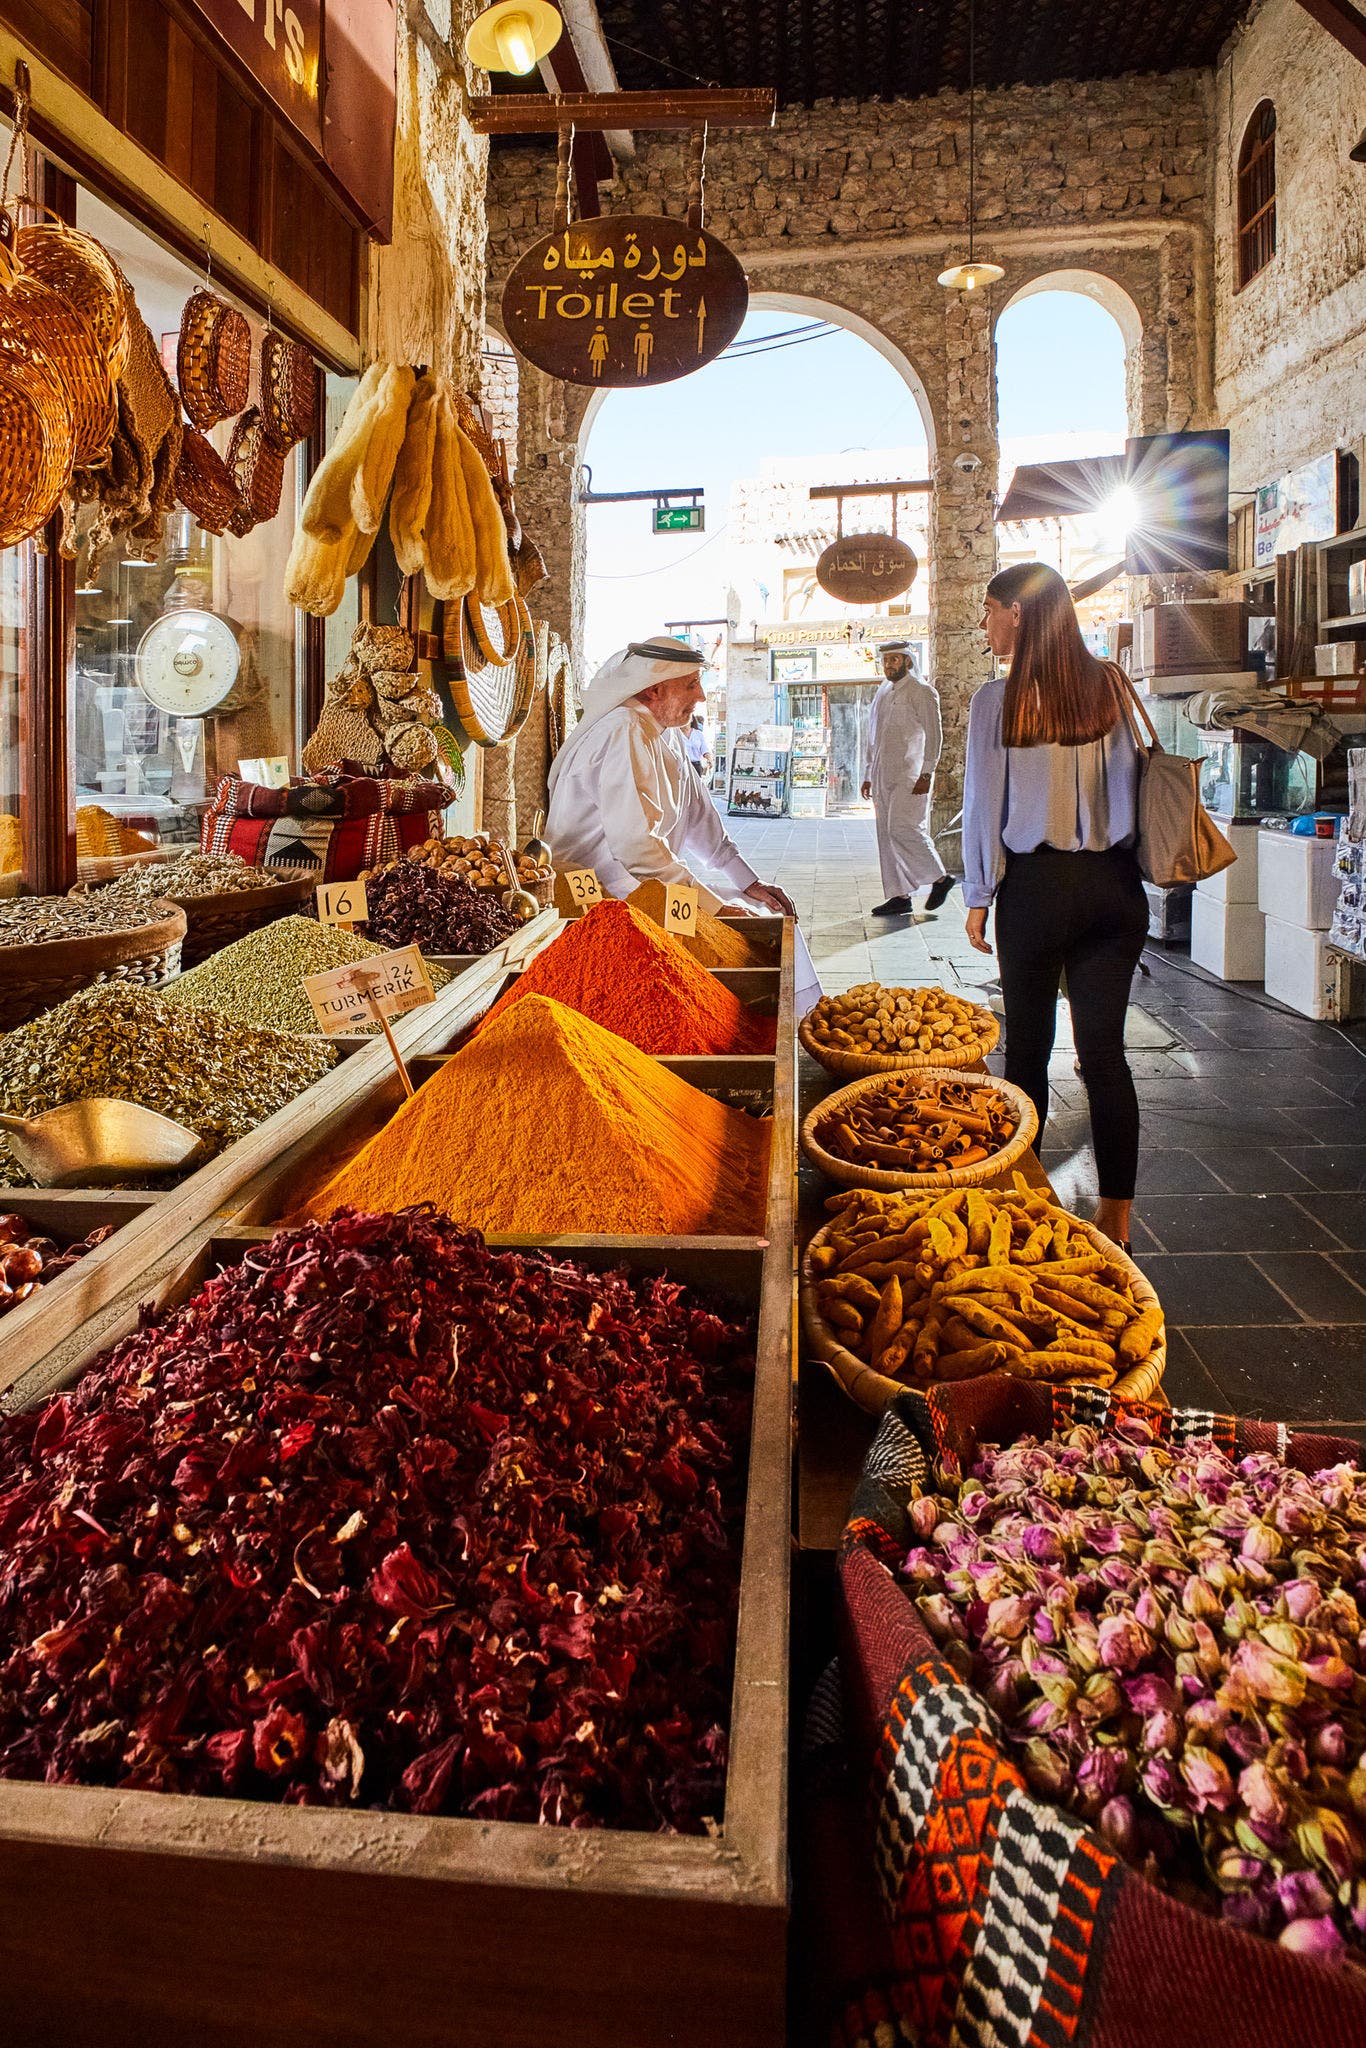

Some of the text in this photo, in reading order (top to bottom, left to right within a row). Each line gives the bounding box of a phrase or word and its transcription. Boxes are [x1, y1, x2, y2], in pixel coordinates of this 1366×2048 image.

[542, 230, 707, 281] دورة مياه
[525, 283, 682, 320] Toilet
[828, 552, 906, 580] سوق الحمام
[763, 627, 841, 645] King Parrot
[572, 874, 598, 898] 32
[324, 889, 352, 917] 16
[671, 900, 691, 921] 20
[391, 963, 414, 979] 24
[319, 976, 416, 1015] TURMERIK
